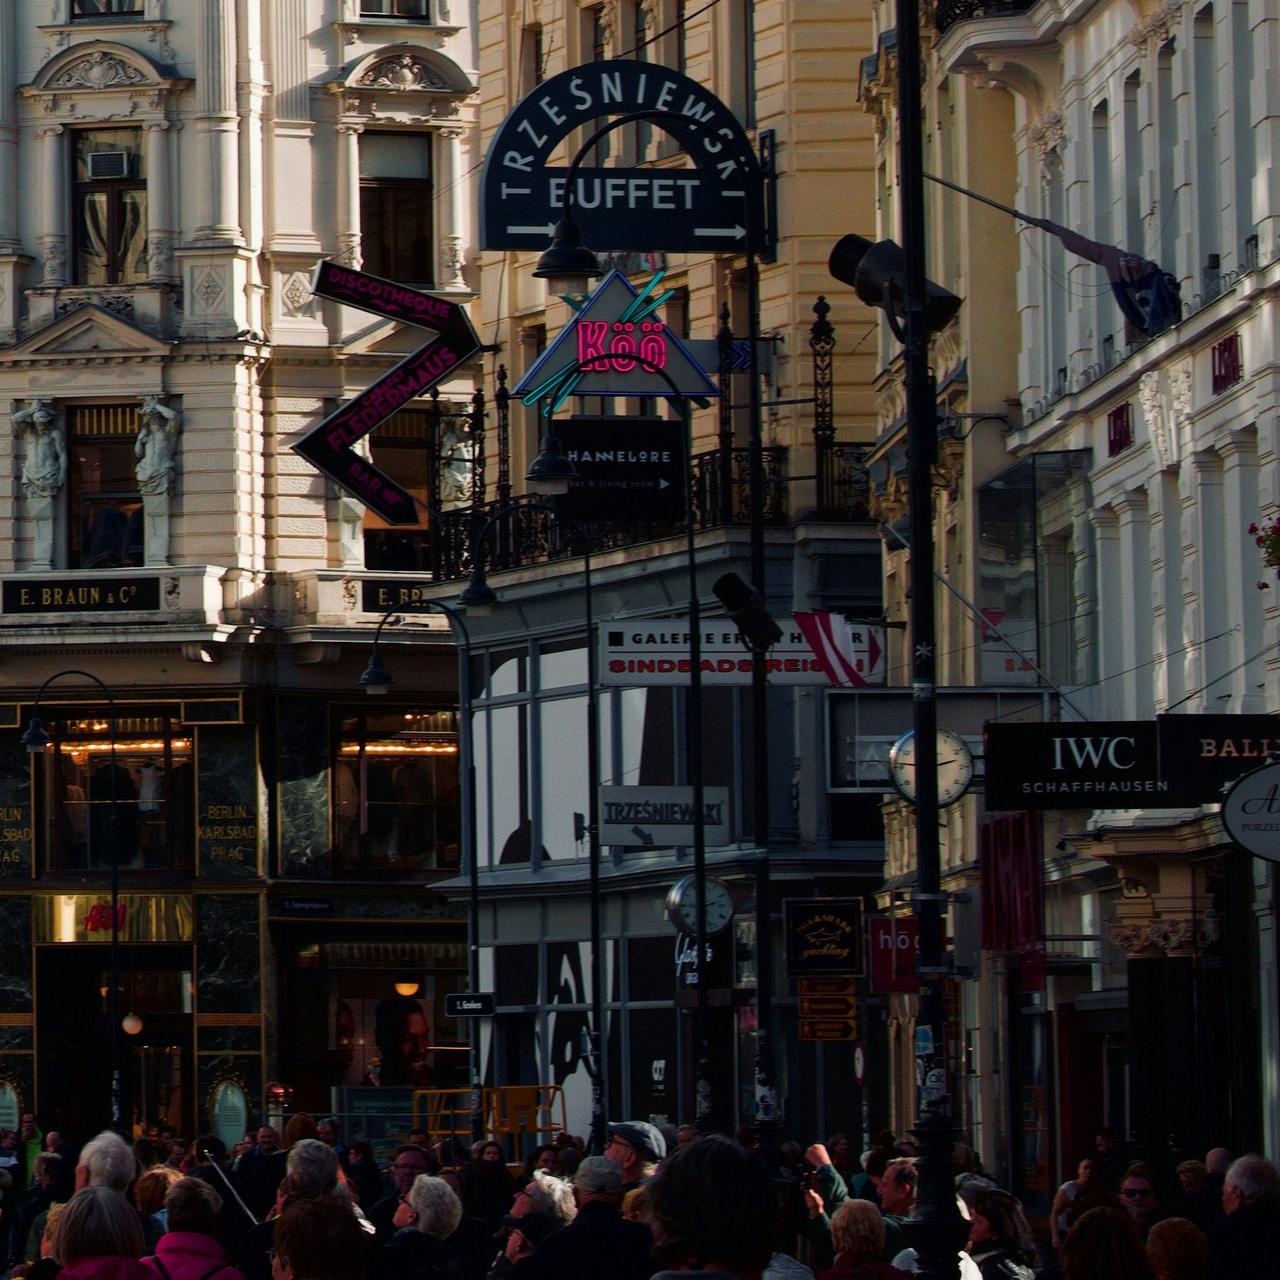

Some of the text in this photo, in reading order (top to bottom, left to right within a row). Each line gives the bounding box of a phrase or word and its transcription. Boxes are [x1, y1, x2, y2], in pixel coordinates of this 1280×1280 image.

[550, 178, 700, 209] BUFFET
[577, 320, 668, 373] Köö
[324, 345, 458, 453] FLEDERMAUS
[567, 450, 671, 463] HANNELORE
[20, 588, 35, 606] E.
[42, 586, 101, 605] BRAUN
[106, 592, 115, 604] &
[377, 588, 393, 606] E.
[1052, 736, 1137, 770] IWC
[1023, 781, 1169, 794] SCHAFFHAUSEN
[1241, 783, 1280, 814] A
[208, 805, 247, 819] BERLIN
[604, 800, 721, 822] TRZEŚNIEWKI
[201, 825, 255, 839] KARLSBAD
[211, 847, 244, 861] PRAG
